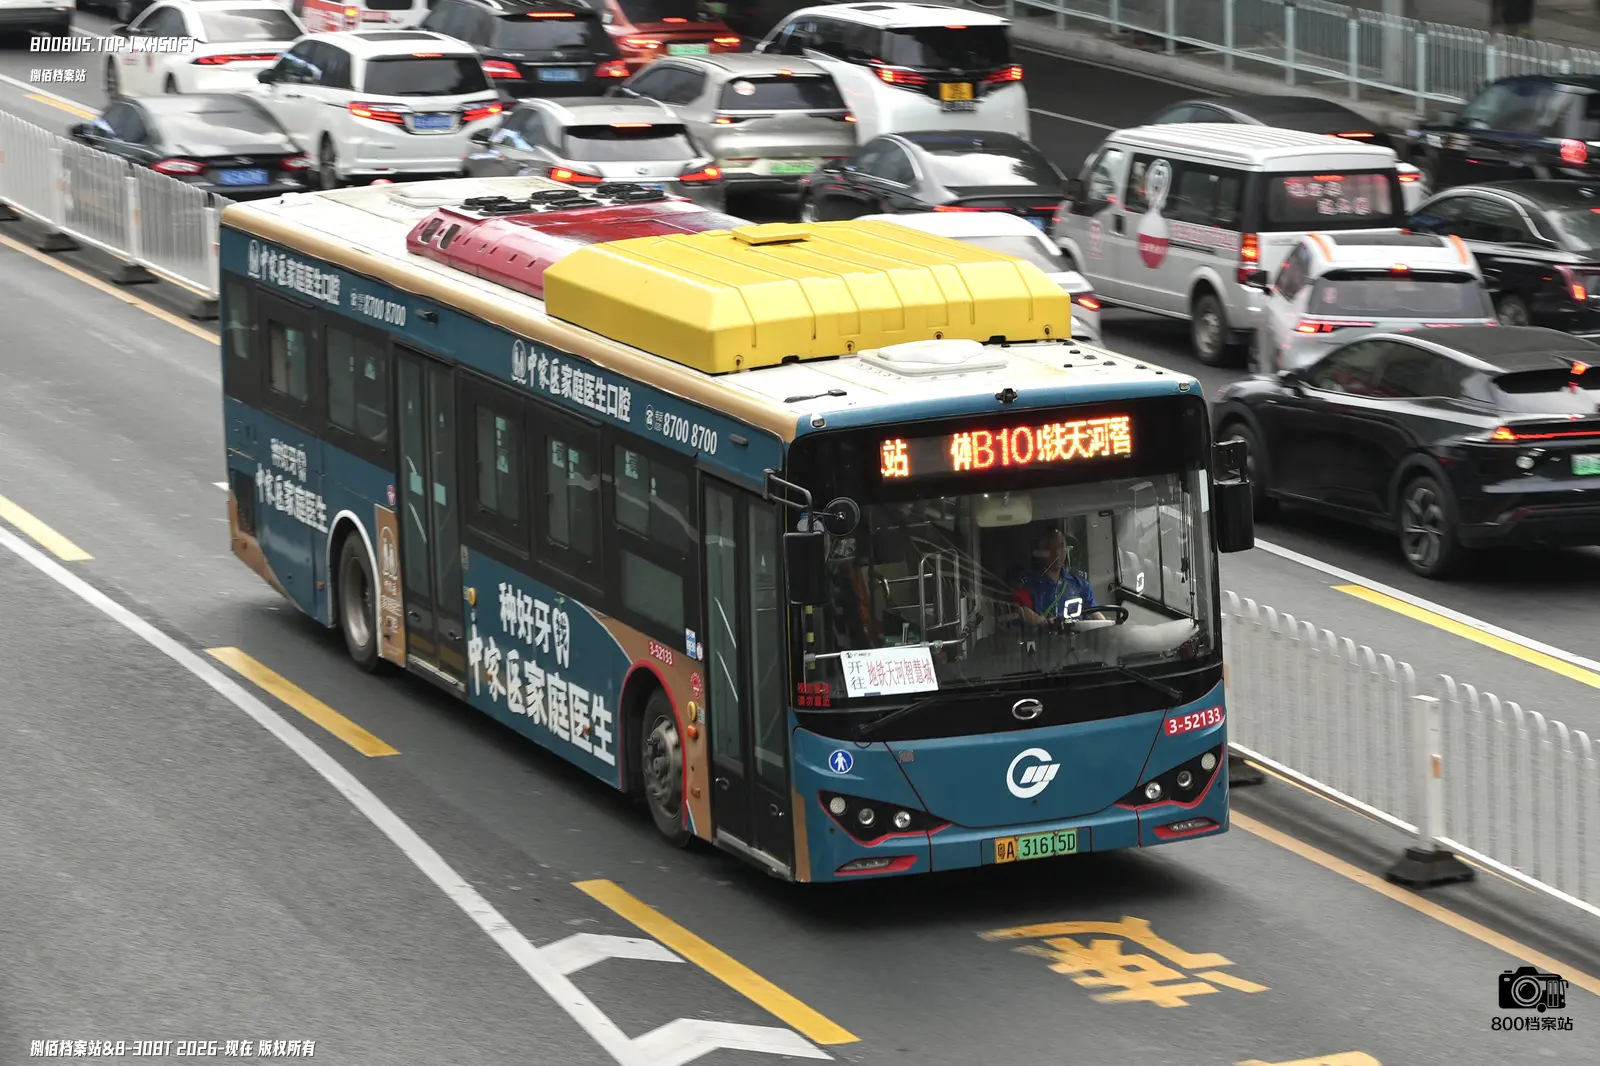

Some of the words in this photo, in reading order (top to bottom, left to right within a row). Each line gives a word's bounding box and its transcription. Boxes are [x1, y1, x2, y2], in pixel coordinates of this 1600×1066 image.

[363, 294, 385, 320] 8700
[384, 301, 406, 327] 8700
[663, 412, 689, 444] 8700
[690, 423, 718, 455] 8700
[972, 426, 1033, 468] B10
[881, 438, 909, 477] 站
[848, 660, 867, 691] 开往
[1169, 707, 1221, 734] 3-52133
